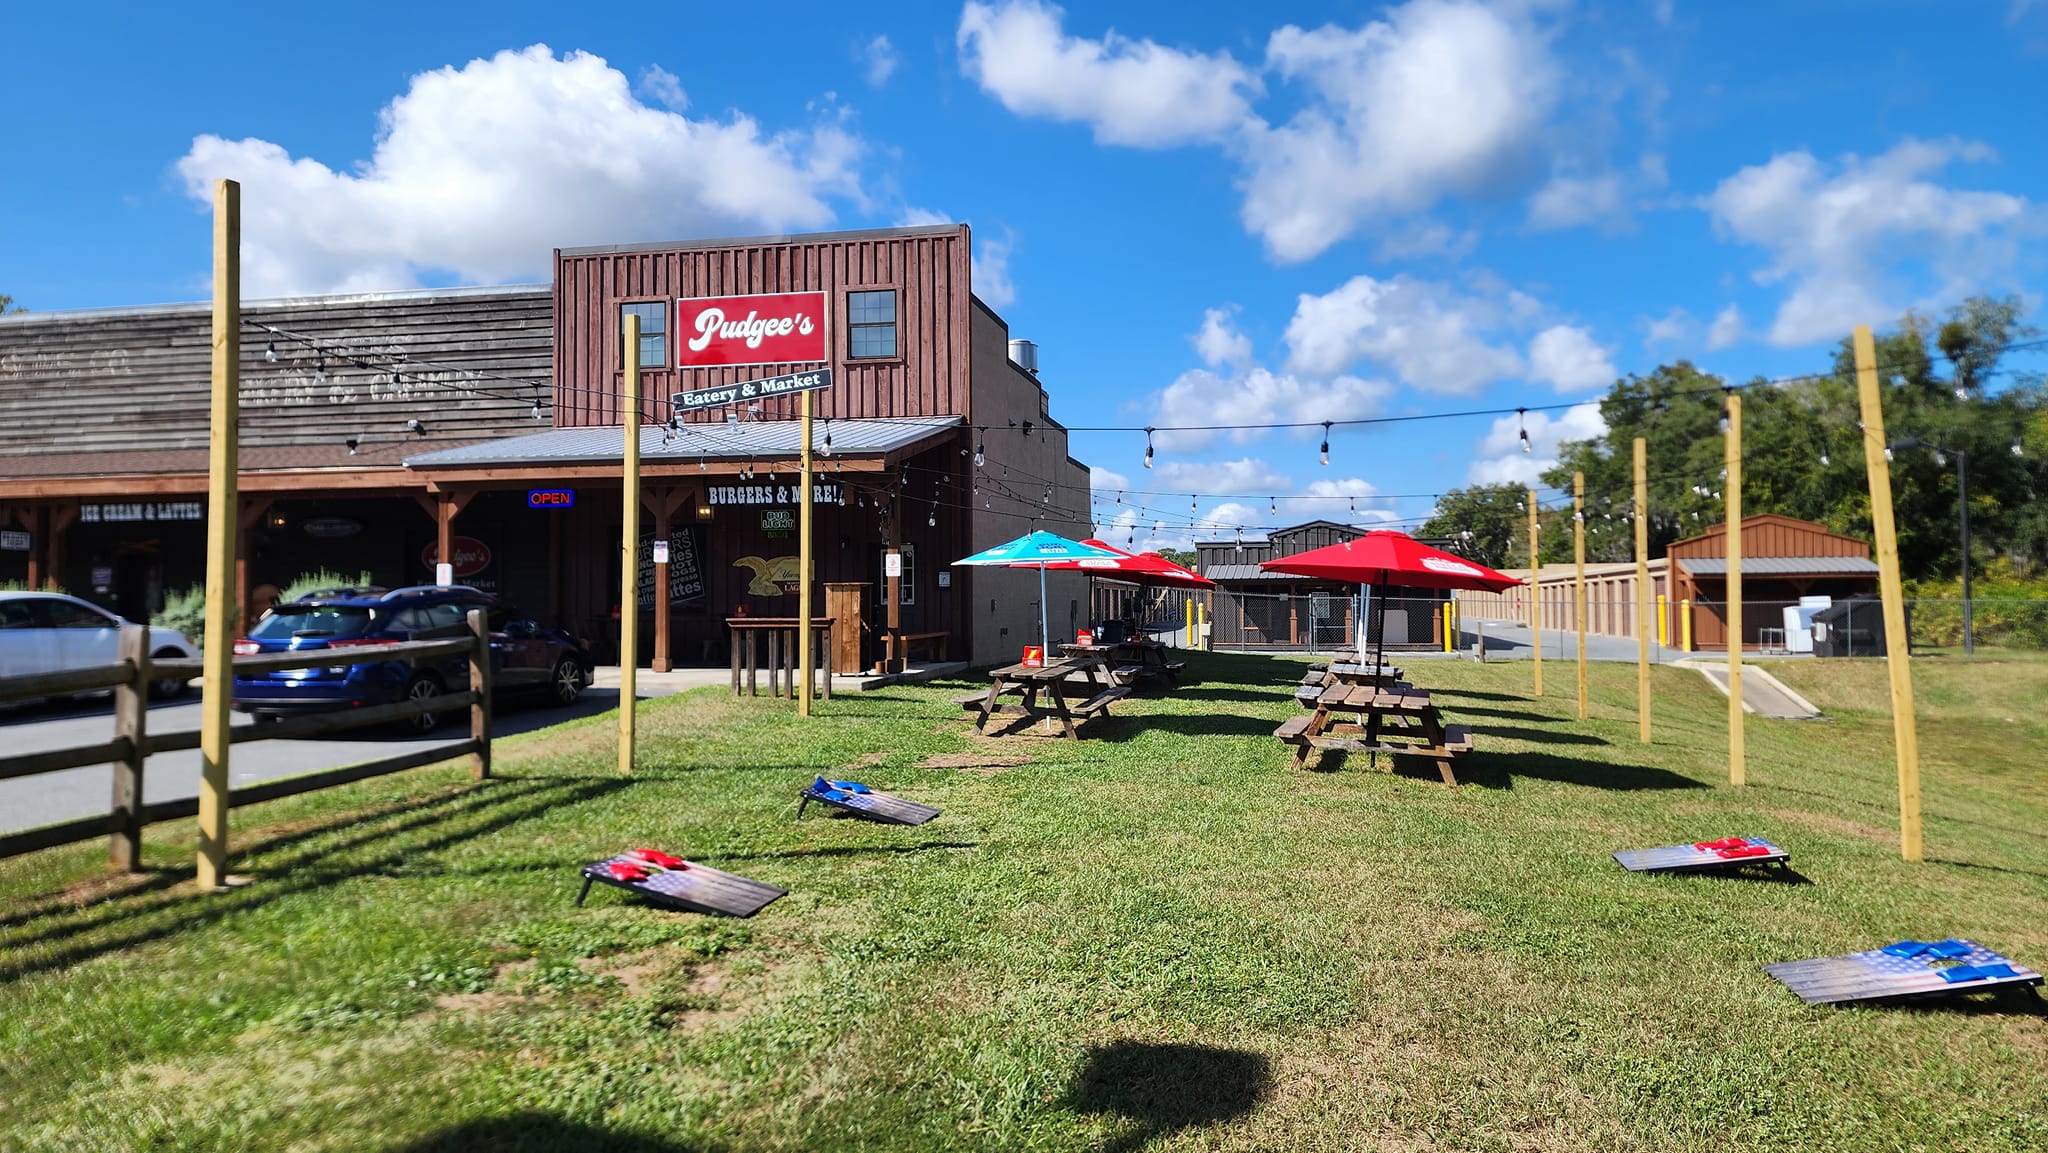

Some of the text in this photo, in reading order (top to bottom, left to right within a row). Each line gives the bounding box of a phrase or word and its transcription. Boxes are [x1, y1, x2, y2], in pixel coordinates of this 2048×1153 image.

[688, 307, 815, 352] Pudgee's
[682, 373, 821, 406] Eatery & Market
[531, 493, 570, 504] OPEN
[709, 485, 837, 504] BURGERS & MRE!
[80, 502, 200, 522] ICE CREAM & LATTES
[766, 511, 790, 520] BUD
[762, 520, 793, 528] LIGHT
